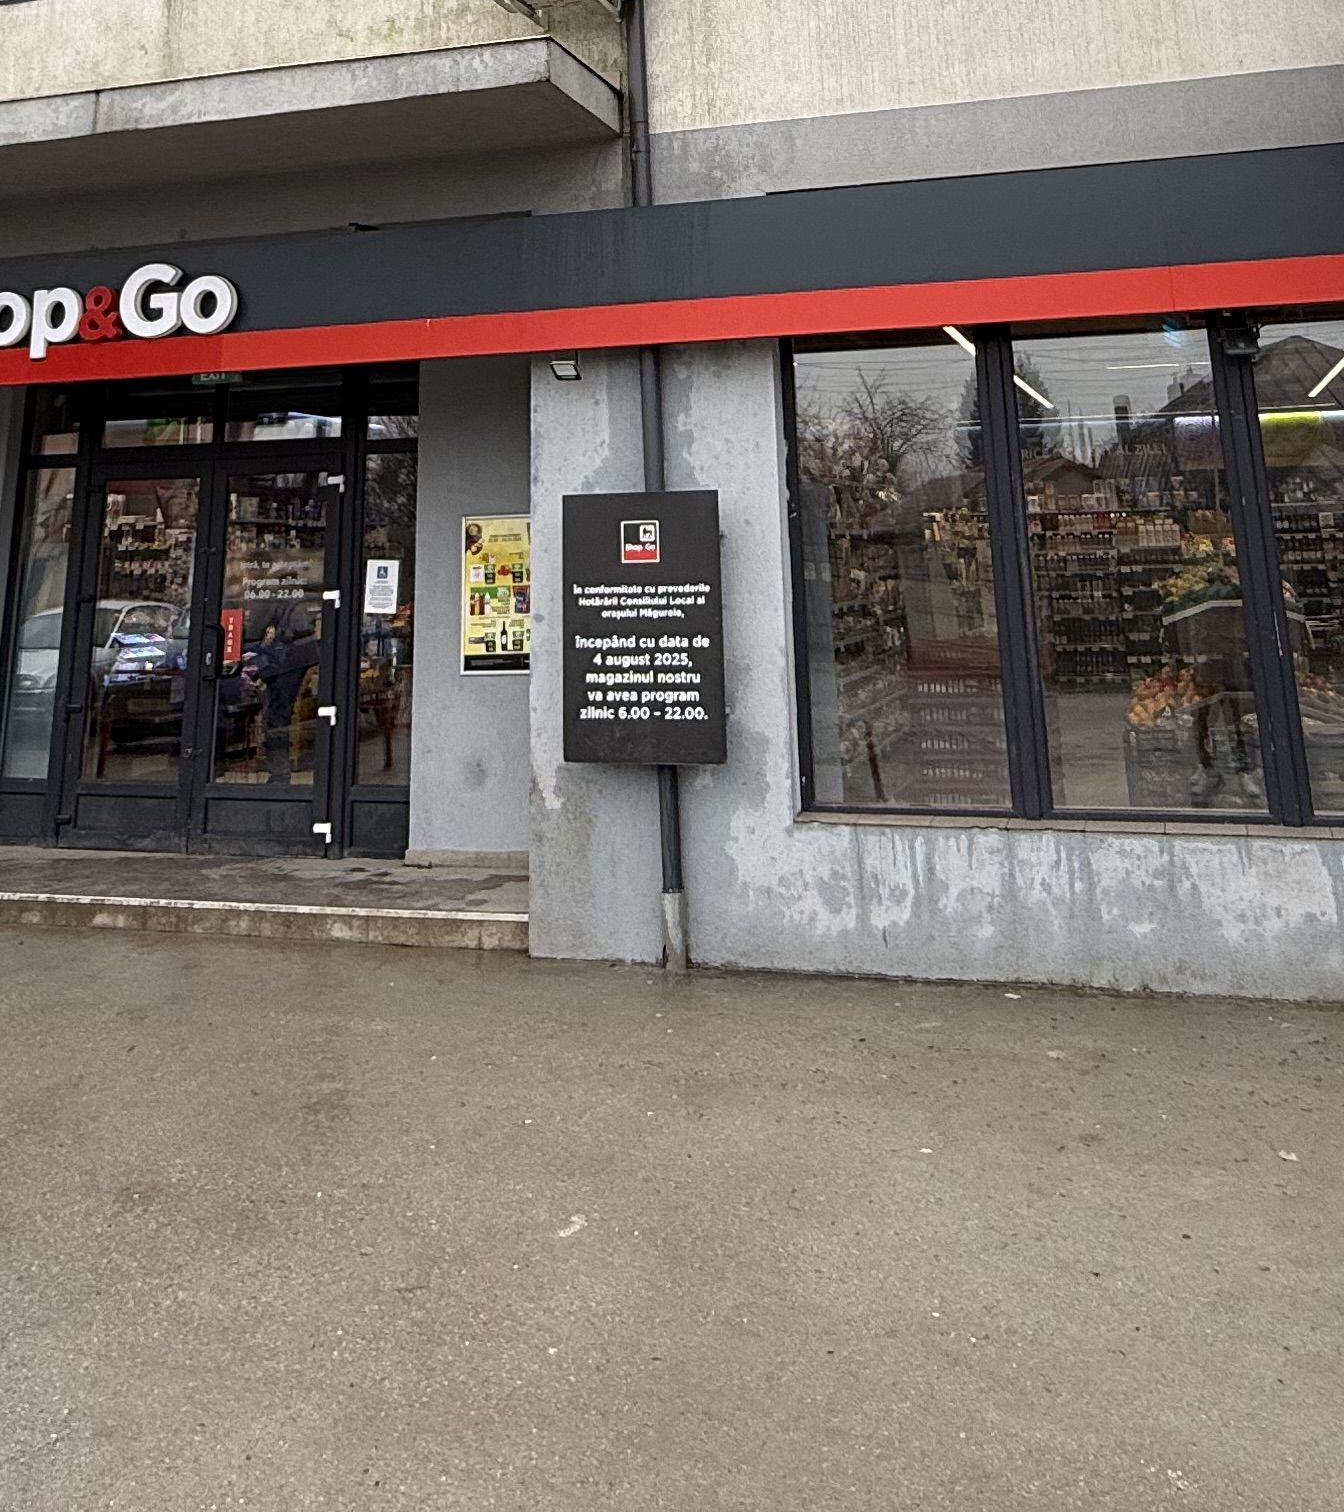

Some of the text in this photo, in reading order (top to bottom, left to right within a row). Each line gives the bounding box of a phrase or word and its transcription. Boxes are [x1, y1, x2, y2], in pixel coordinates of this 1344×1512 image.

[584, 584, 642, 594] conformitate
[645, 585, 655, 594] cu
[657, 583, 711, 595] prevederile
[620, 596, 667, 605] Consiliului
[670, 596, 694, 605] Local
[697, 596, 705, 605] al
[639, 637, 655, 648] cu
[659, 635, 689, 648] data
[692, 635, 710, 648] de
[592, 653, 692, 667] 4 august 2025,
[586, 670, 701, 685] magazinul nostru
[587, 691, 700, 703] va avea program
[579, 706, 615, 719] zilnic
[618, 706, 650, 720] 6.00
[664, 706, 708, 720] 22.00.
